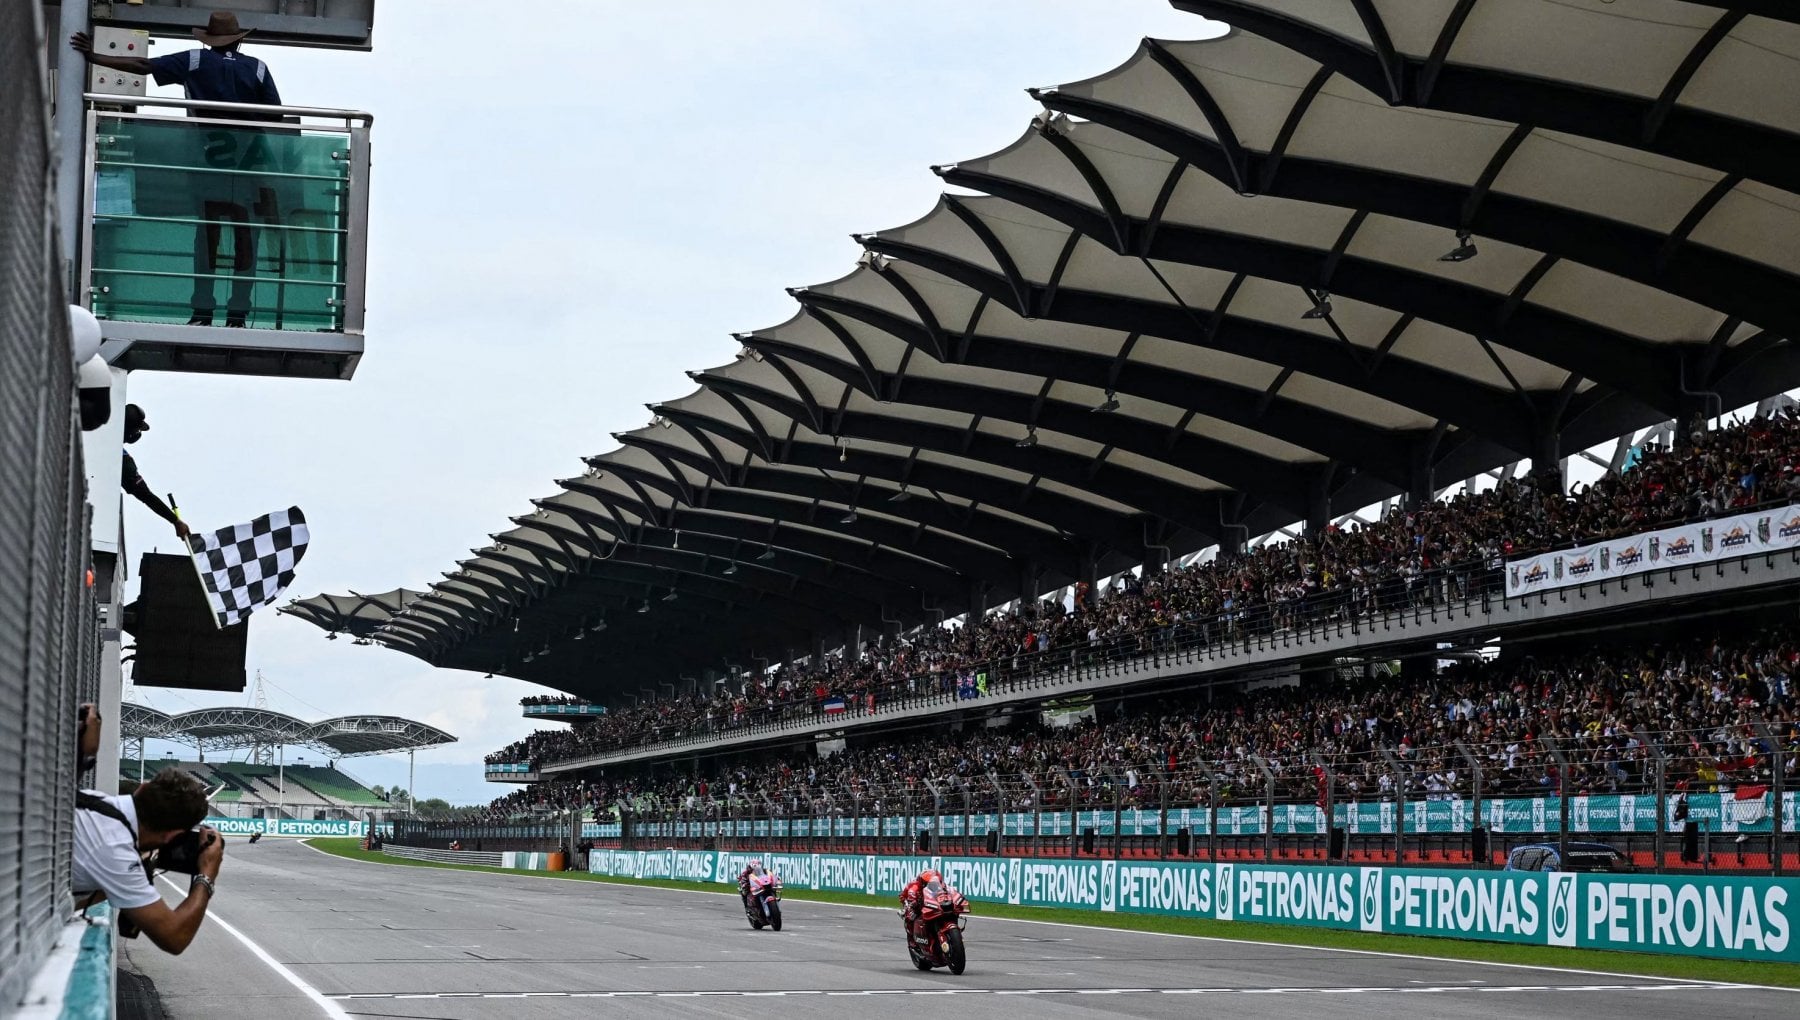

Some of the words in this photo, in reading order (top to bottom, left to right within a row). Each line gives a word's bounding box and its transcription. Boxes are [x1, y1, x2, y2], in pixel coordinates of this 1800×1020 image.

[281, 822, 347, 834] PETRONAS
[772, 857, 810, 885] PETRONAS
[821, 859, 865, 890] PETRONAS
[944, 861, 1006, 898] PETRONAS
[1024, 864, 1098, 905] PETRONAS
[1120, 867, 1210, 912] PETRONAS
[1239, 870, 1354, 923] PETRONAS
[1390, 875, 1539, 936] PETRONAS
[1587, 882, 1790, 953] PETRONAS
